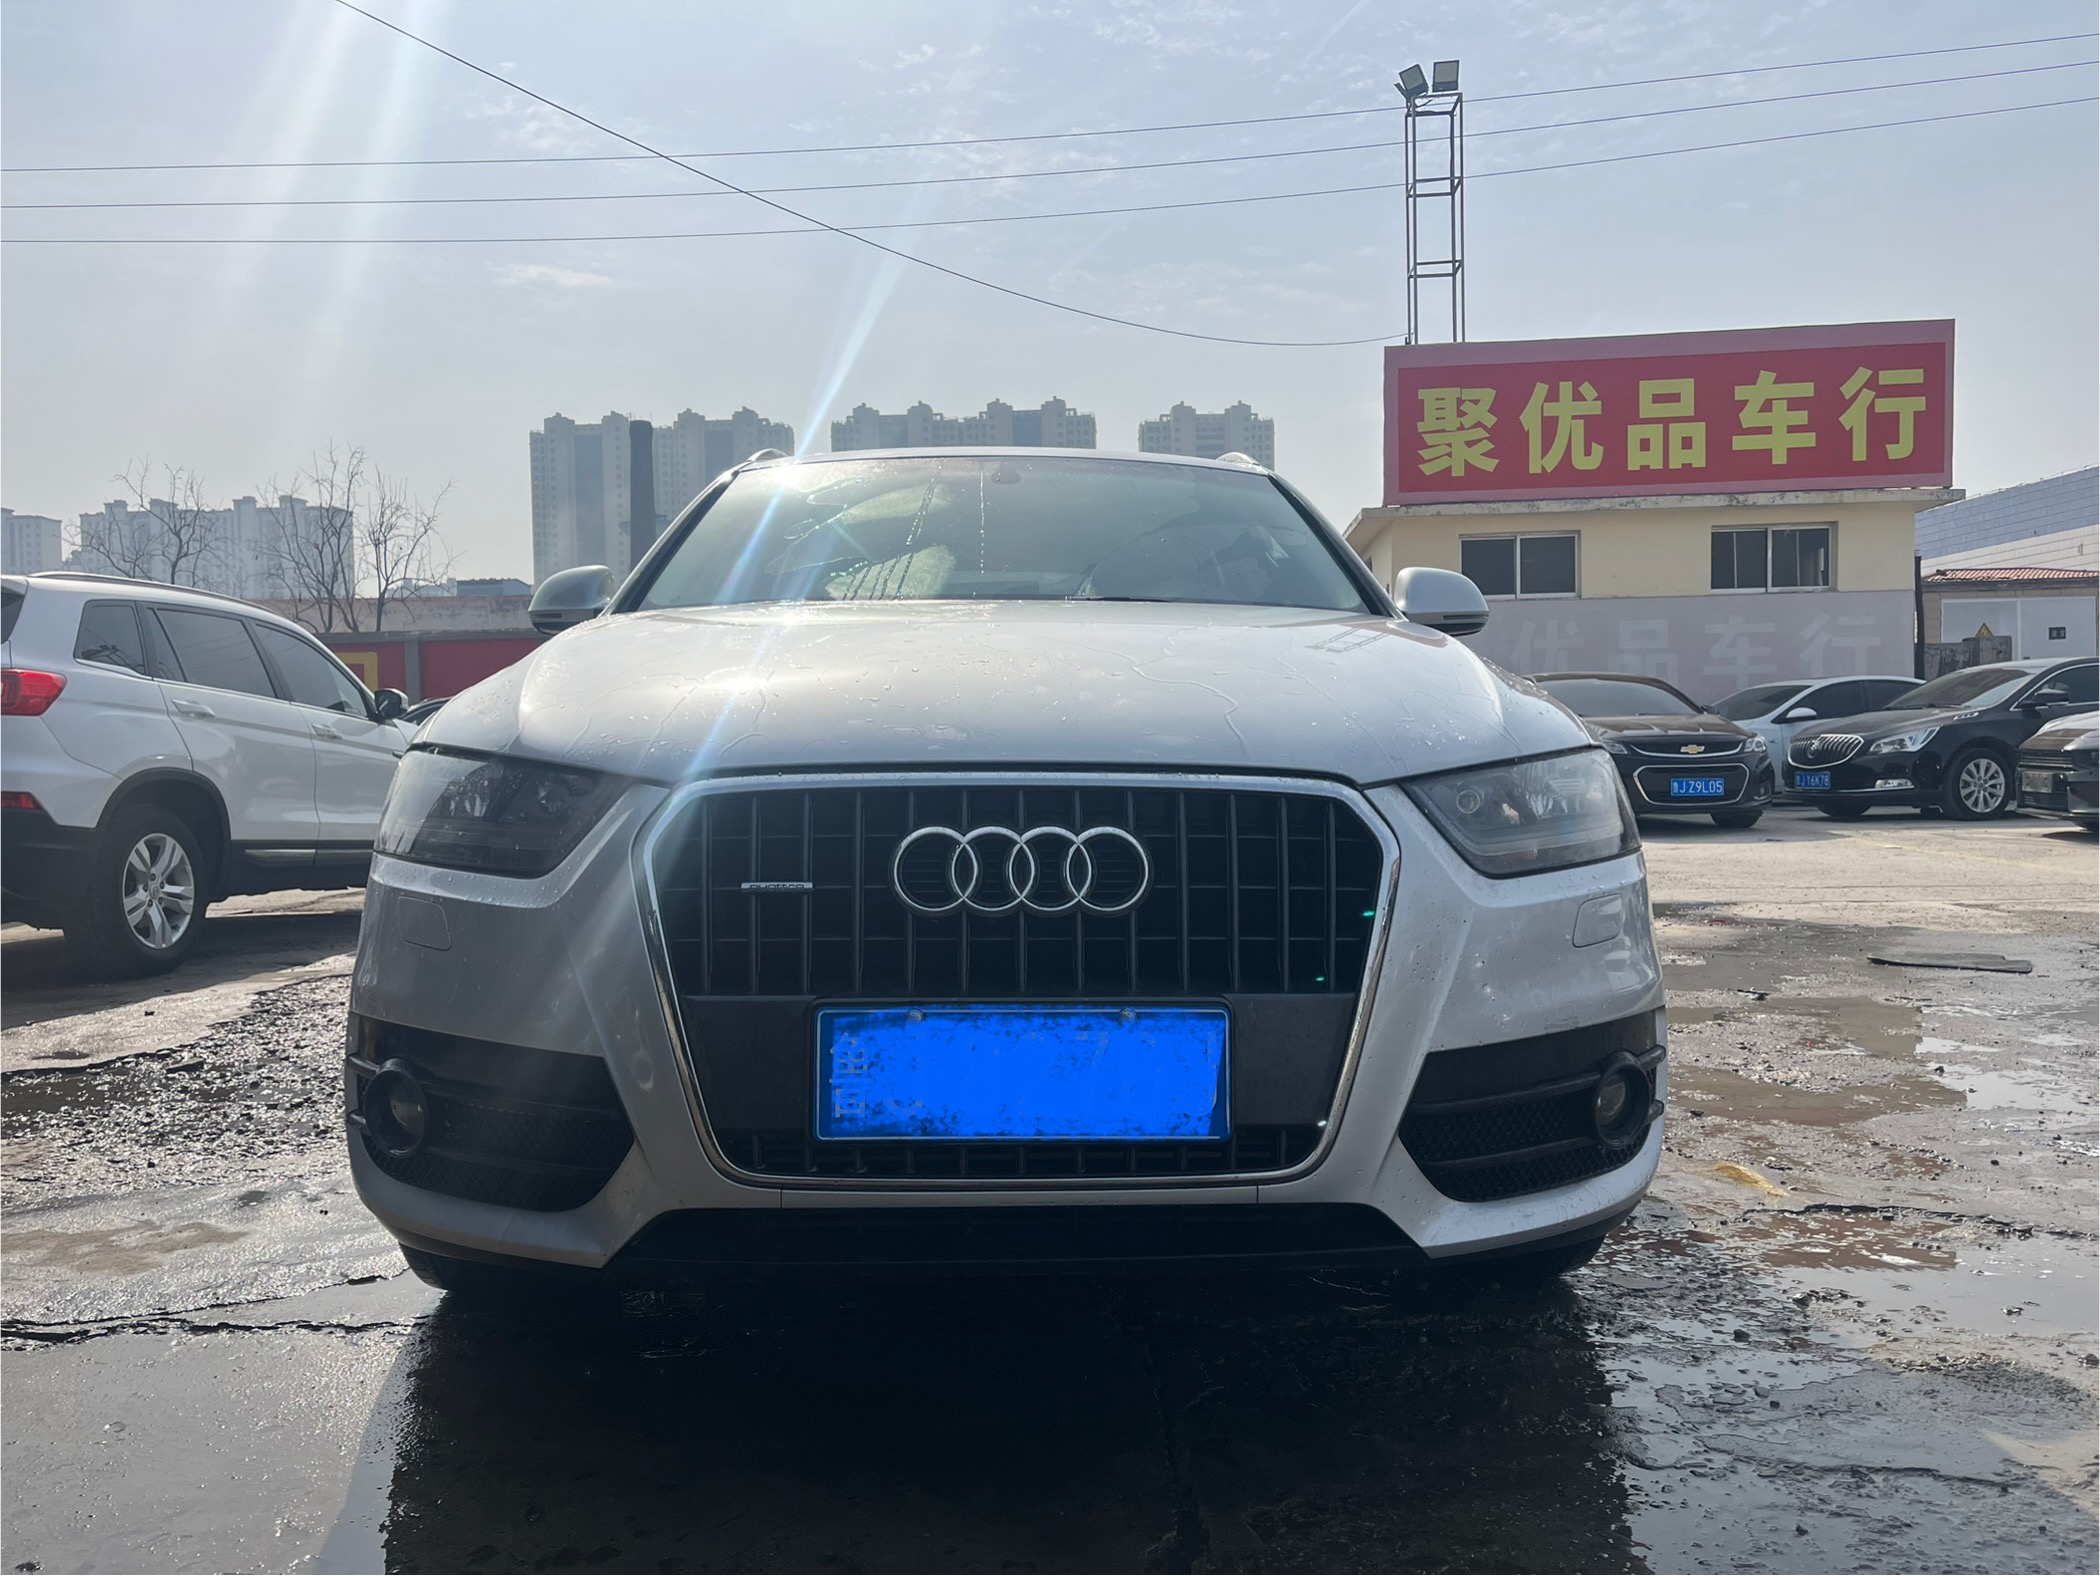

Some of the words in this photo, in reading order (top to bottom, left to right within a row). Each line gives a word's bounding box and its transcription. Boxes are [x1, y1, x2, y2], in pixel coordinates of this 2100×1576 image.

[1416, 366, 1927, 478] 聚优品车行
